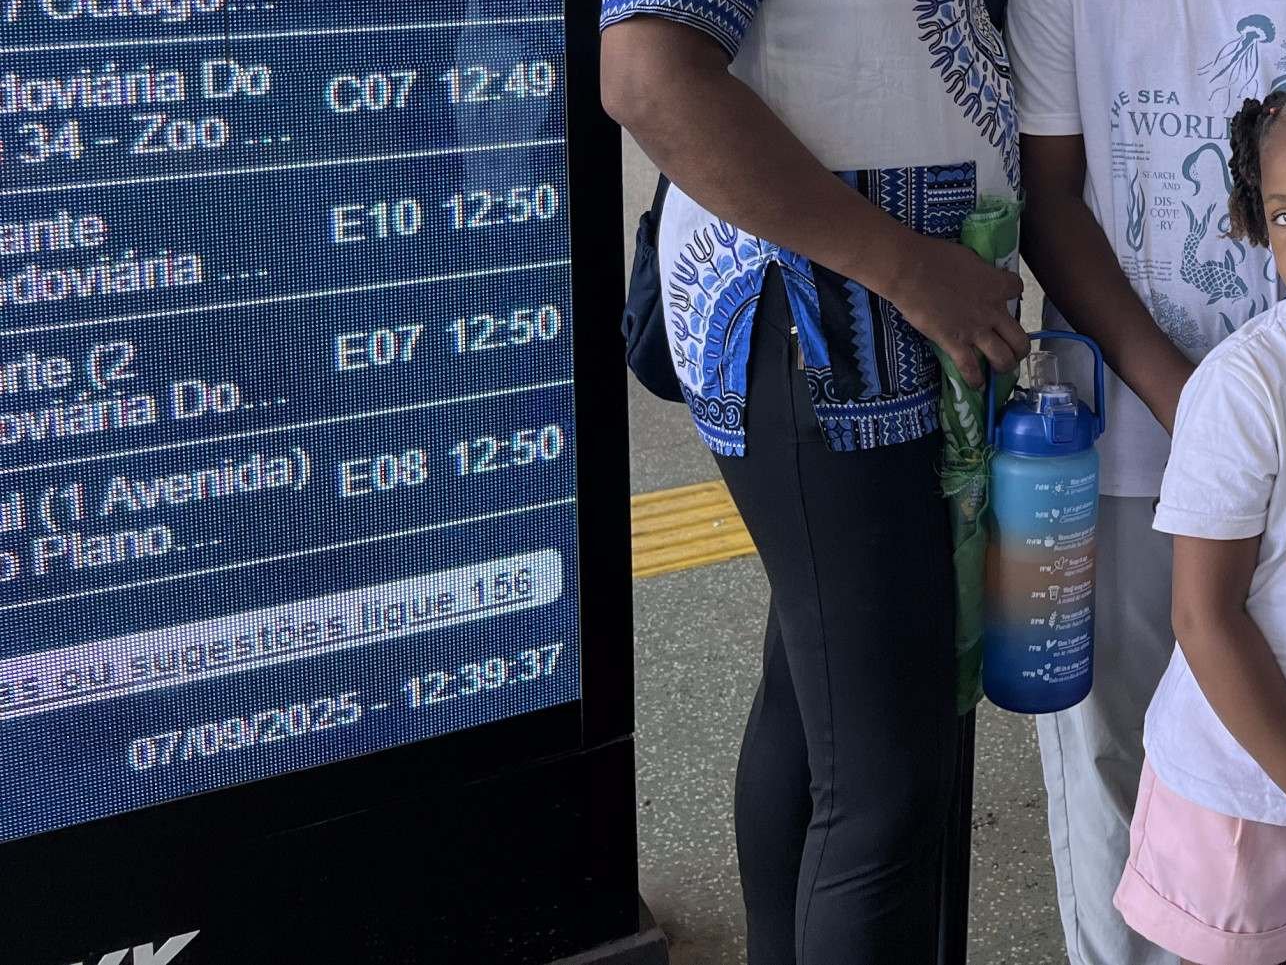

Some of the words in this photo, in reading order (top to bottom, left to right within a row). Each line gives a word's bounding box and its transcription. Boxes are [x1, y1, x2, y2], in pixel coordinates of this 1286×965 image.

[202, 59, 272, 98] Do
[326, 68, 417, 114] C07
[440, 61, 556, 105] 12:49
[1111, 91, 1130, 132] THE
[1137, 89, 1180, 106] SEA
[18, 119, 84, 163] 34
[330, 198, 423, 244] E10
[442, 183, 558, 230] 12:50
[1162, 182, 1181, 191] AND
[0, 352, 72, 394] rte
[87, 340, 137, 389] (2
[335, 322, 424, 373] E07
[450, 303, 562, 354] 12:50
[40, 483, 85, 532] (1
[100, 447, 311, 516] Avenida)
[338, 448, 429, 499] E08
[449, 423, 565, 478] 12:50
[59, 664, 115, 693] ou
[129, 615, 348, 678] sugestões
[360, 589, 457, 633] ligue
[470, 567, 534, 605] 156
[127, 691, 363, 773] 07/09/2025
[402, 642, 565, 710] 12:39:37
